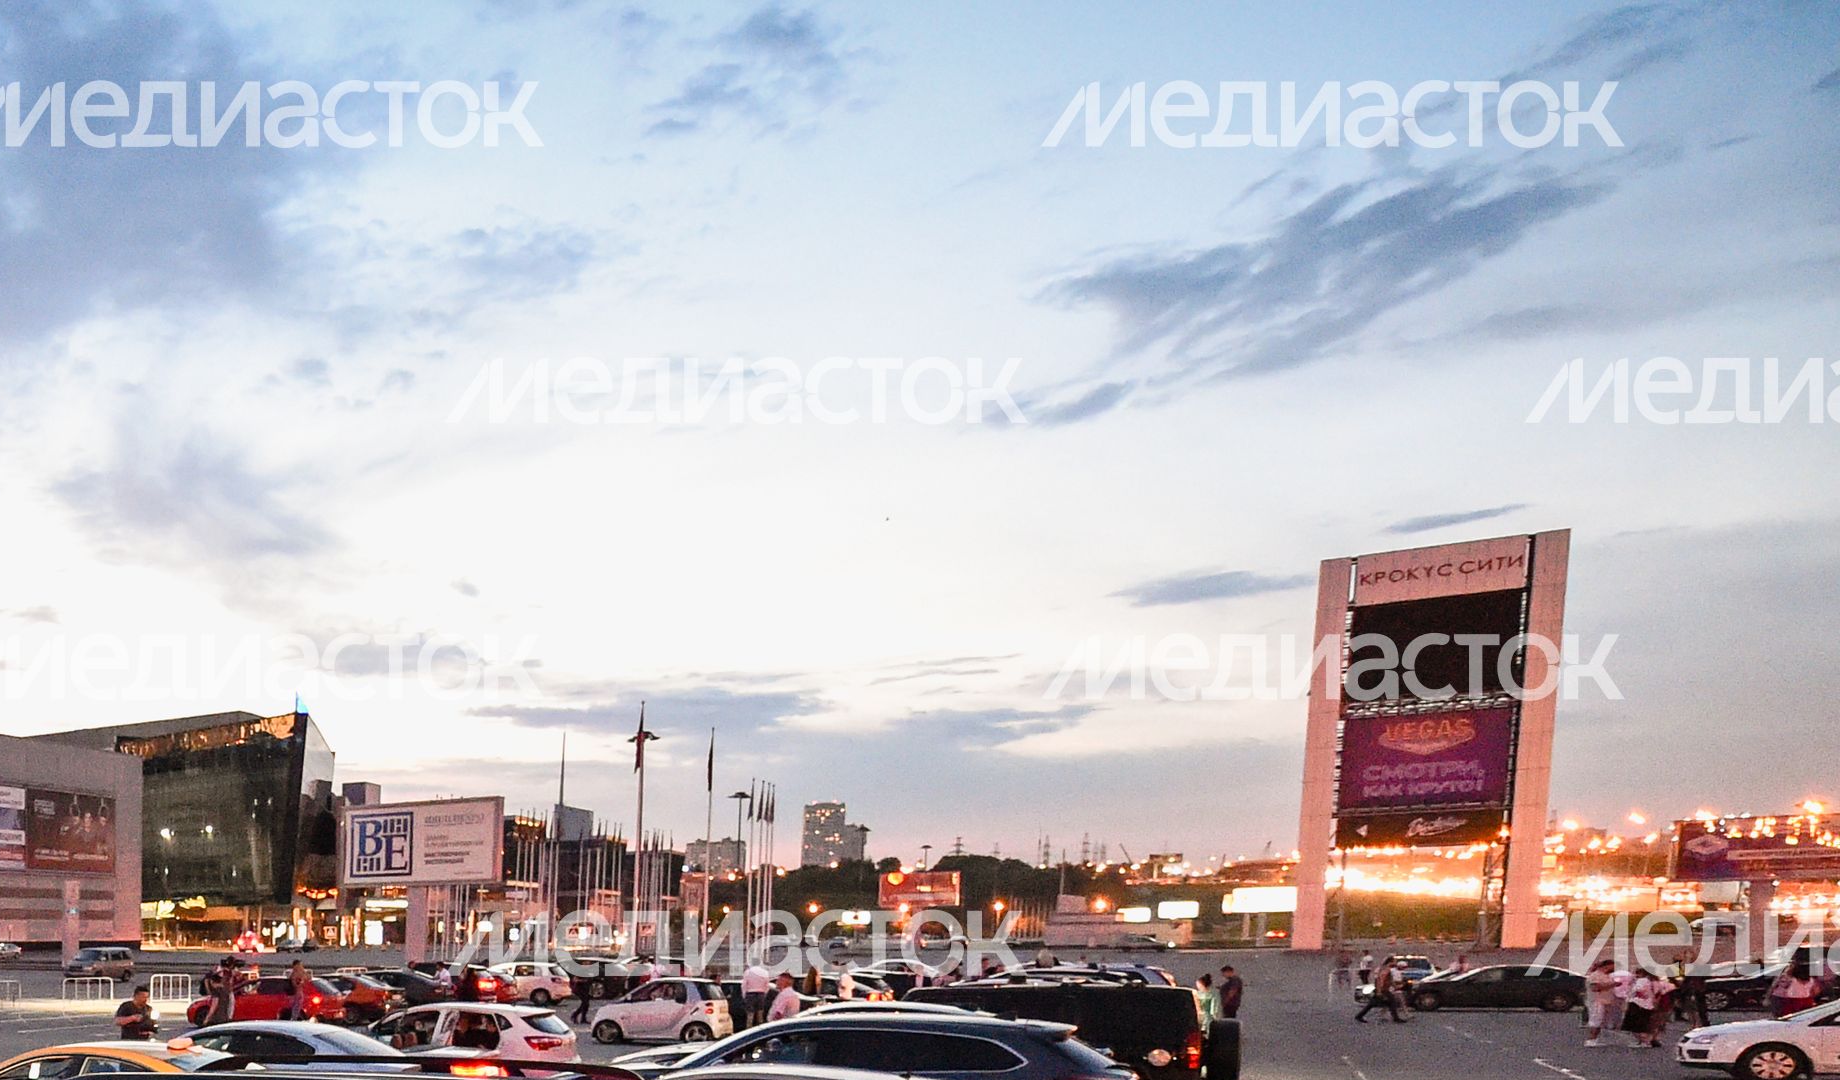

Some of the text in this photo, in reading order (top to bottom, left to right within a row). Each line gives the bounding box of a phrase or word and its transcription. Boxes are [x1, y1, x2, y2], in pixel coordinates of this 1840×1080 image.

[1360, 554, 1524, 586] КРОКУС СИТИ
[1385, 718, 1472, 741] VEGAS
